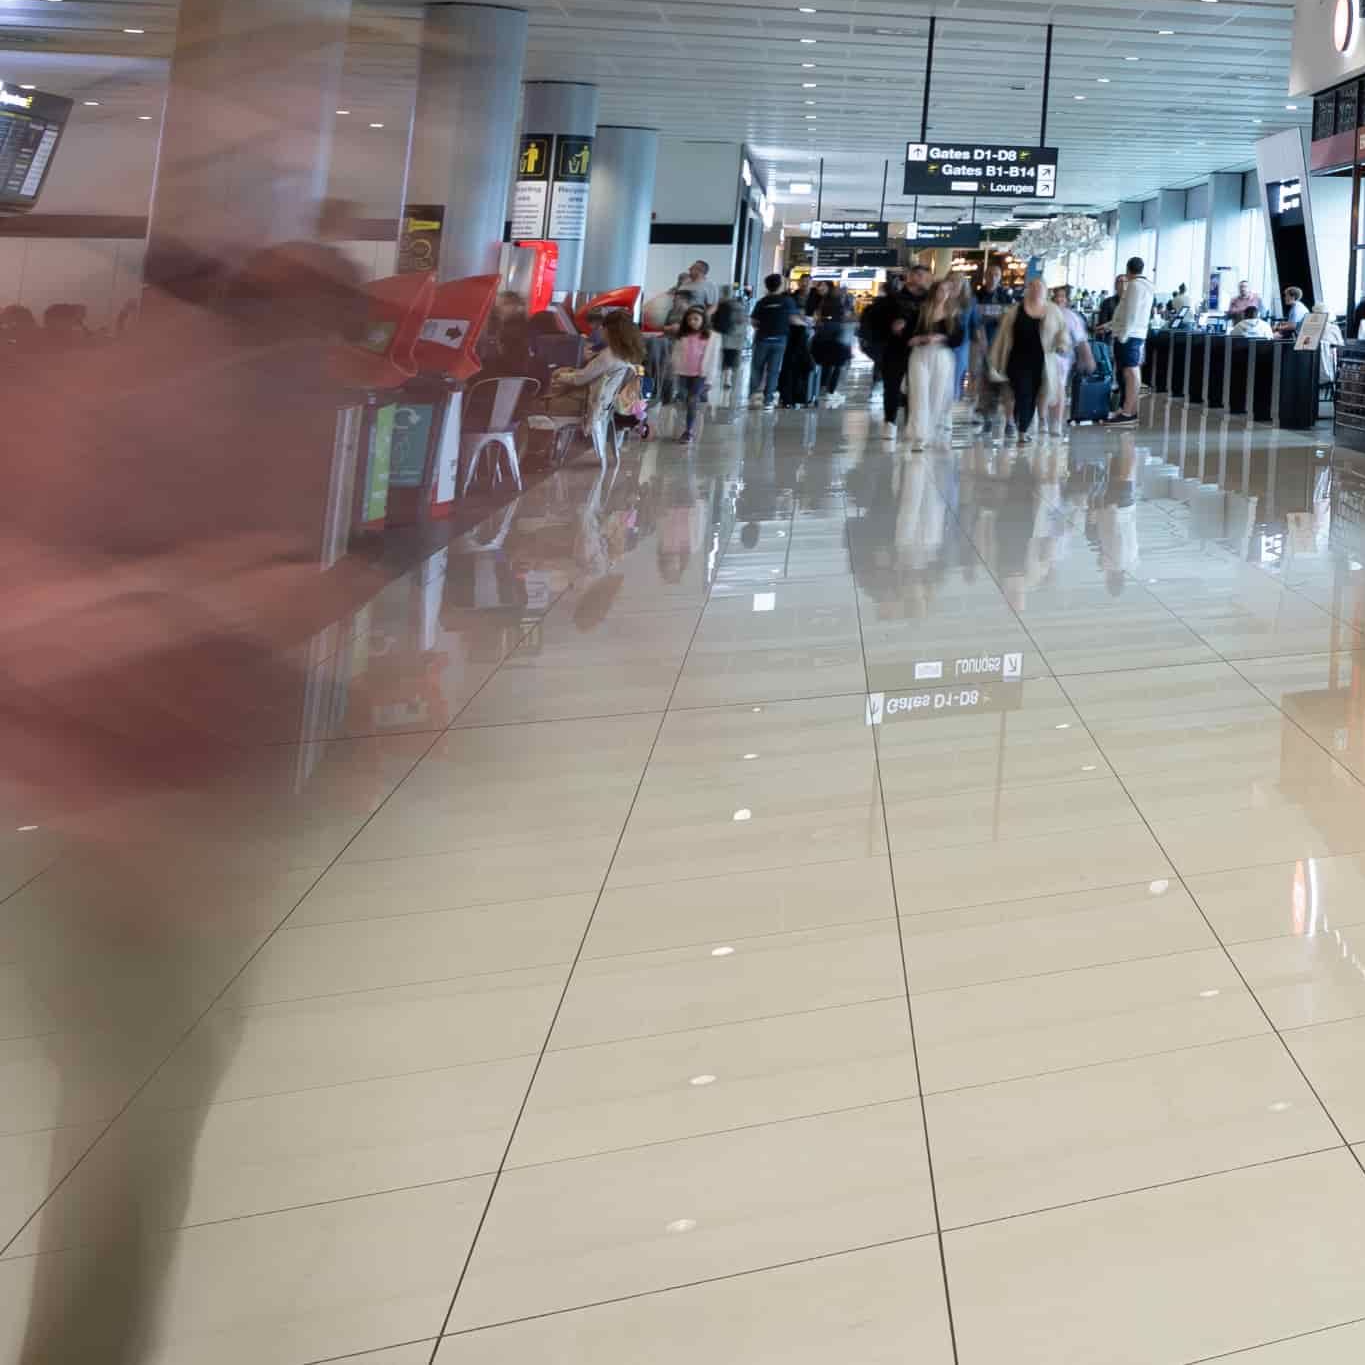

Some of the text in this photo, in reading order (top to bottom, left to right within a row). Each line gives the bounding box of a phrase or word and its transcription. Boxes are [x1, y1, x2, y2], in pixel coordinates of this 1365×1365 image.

[929, 147, 1017, 161] Gates D1-D8
[942, 164, 1035, 177] Gates B1-B14
[990, 182, 1034, 194] Lounges
